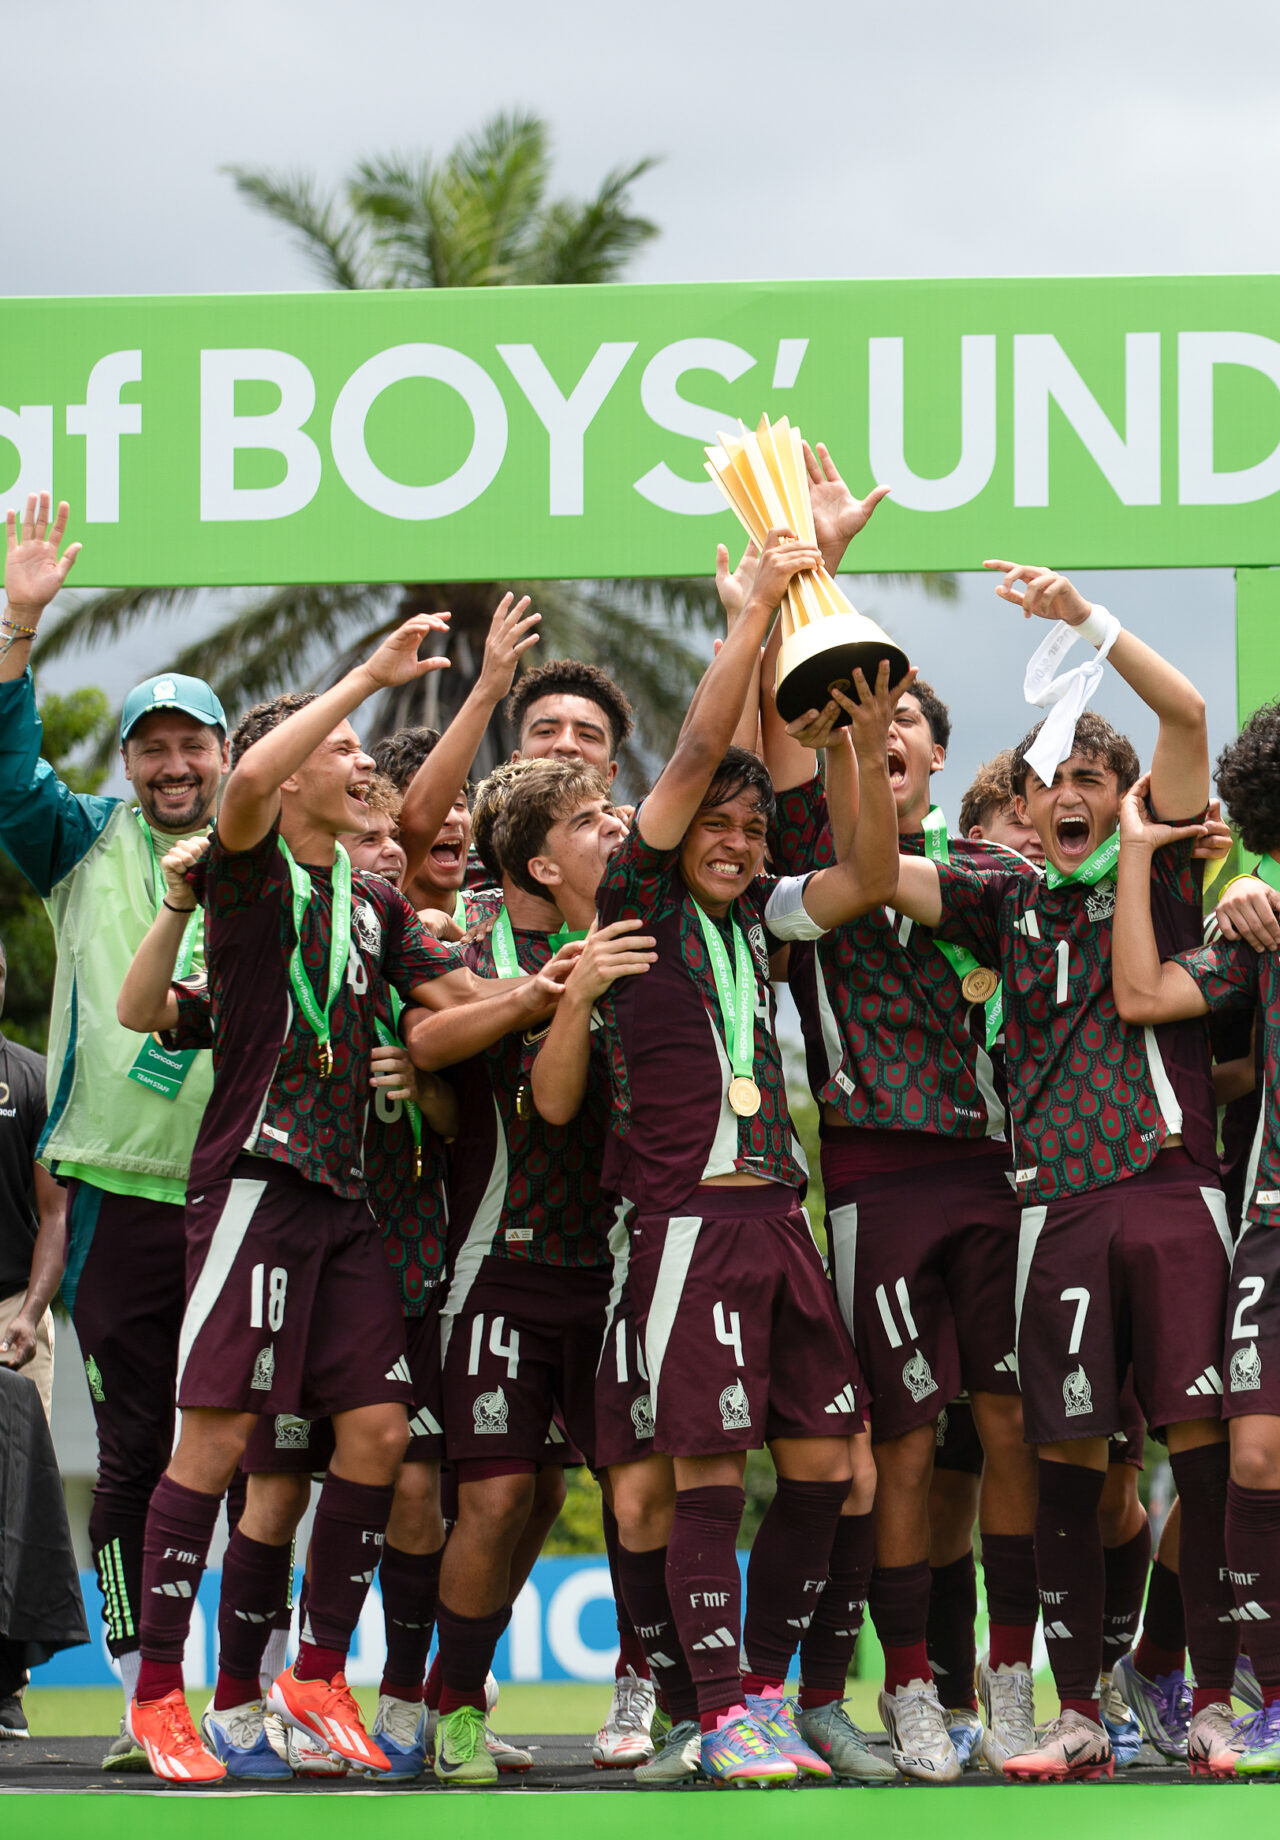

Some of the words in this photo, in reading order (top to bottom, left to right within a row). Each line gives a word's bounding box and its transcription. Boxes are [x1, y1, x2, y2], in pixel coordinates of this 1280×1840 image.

[293, 960, 325, 1030] CHAMPIONSHIP
[739, 990, 750, 1063] CHAMPIONSHIP
[136, 1072, 154, 1086] TEAM
[152, 1078, 170, 1094] STAFF
[147, 1049, 183, 1071] Concacaf
[250, 1263, 289, 1332] 18
[875, 1276, 919, 1349] 11
[1060, 1287, 1091, 1355] 7
[1231, 1276, 1265, 1340] 2
[467, 1313, 520, 1379] 14
[712, 1300, 746, 1367] 4
[163, 1547, 201, 1565] FMF
[361, 1530, 386, 1546] FM
[689, 1591, 731, 1608] FMF
